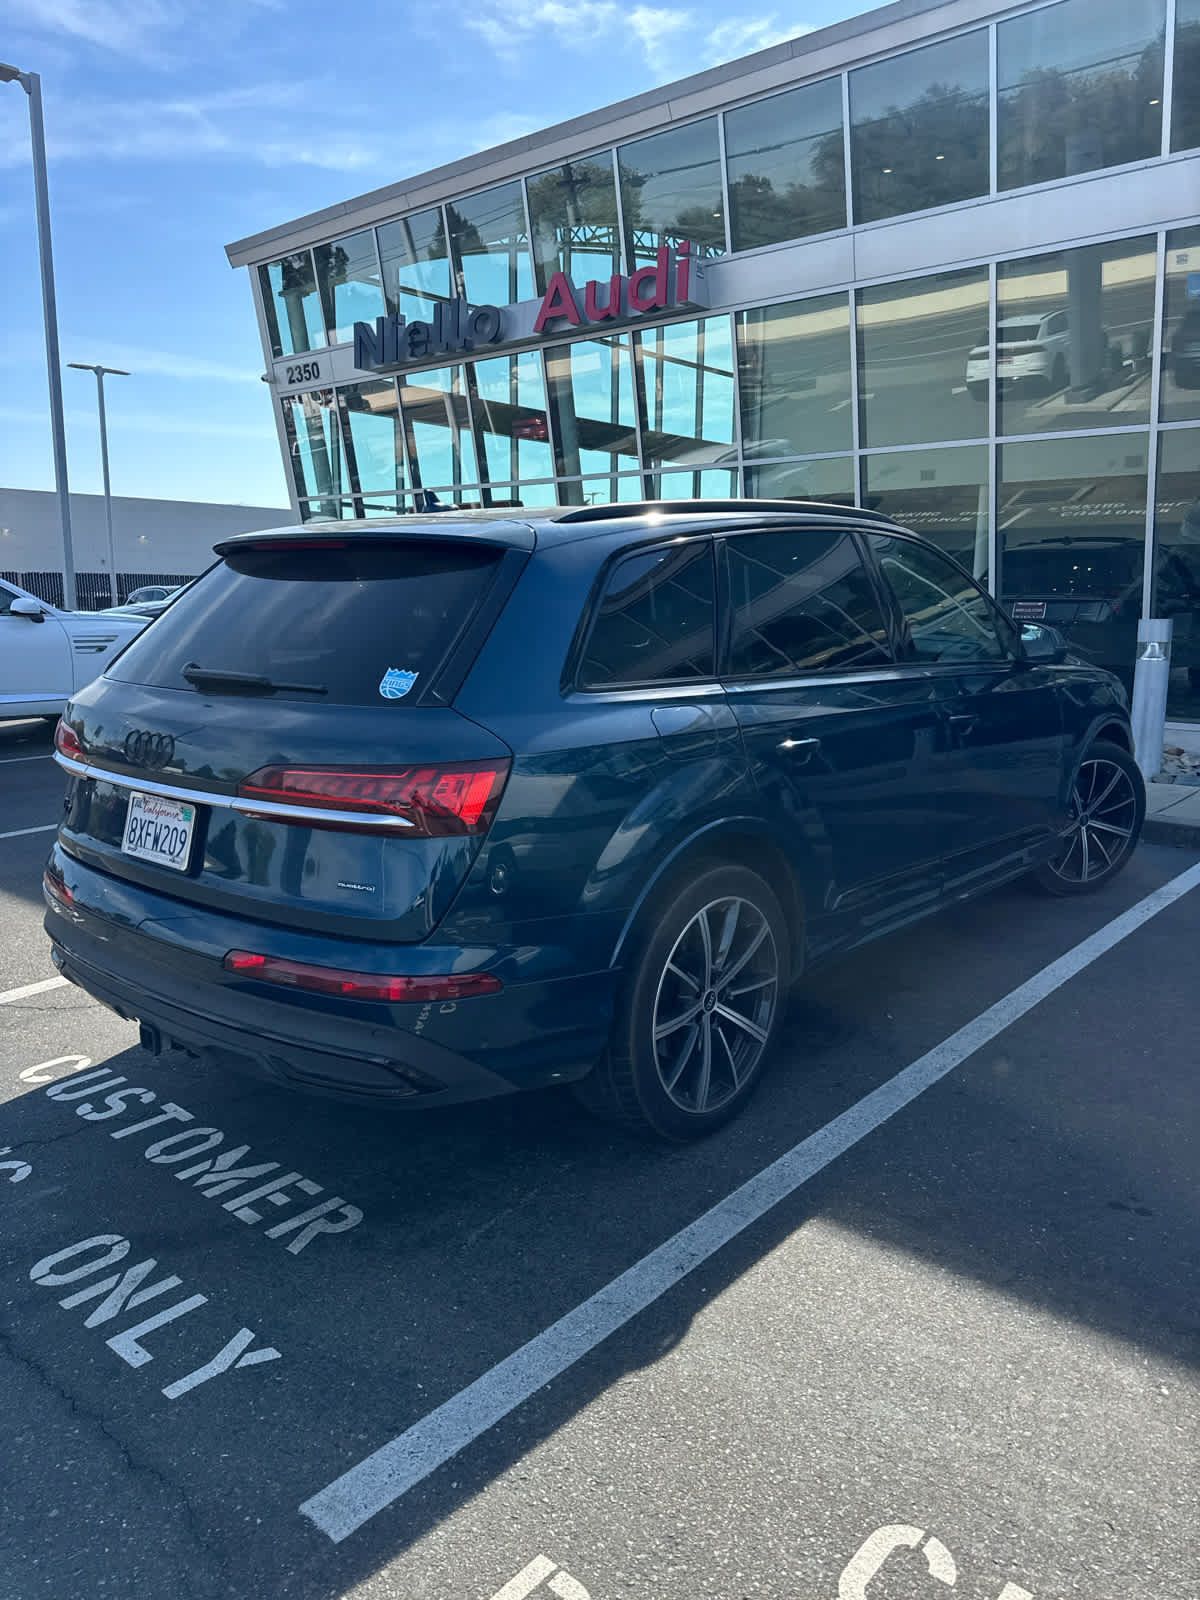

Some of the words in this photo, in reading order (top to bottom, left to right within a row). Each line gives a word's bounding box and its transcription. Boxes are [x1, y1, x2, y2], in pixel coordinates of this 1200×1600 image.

[354, 298, 505, 369] Niello
[534, 240, 691, 334] Audi
[286, 362, 320, 385] 2350
[128, 816, 188, 858] 8XFW209
[19, 1054, 365, 1256] CUSTOMER
[29, 1233, 283, 1400] ONLY
